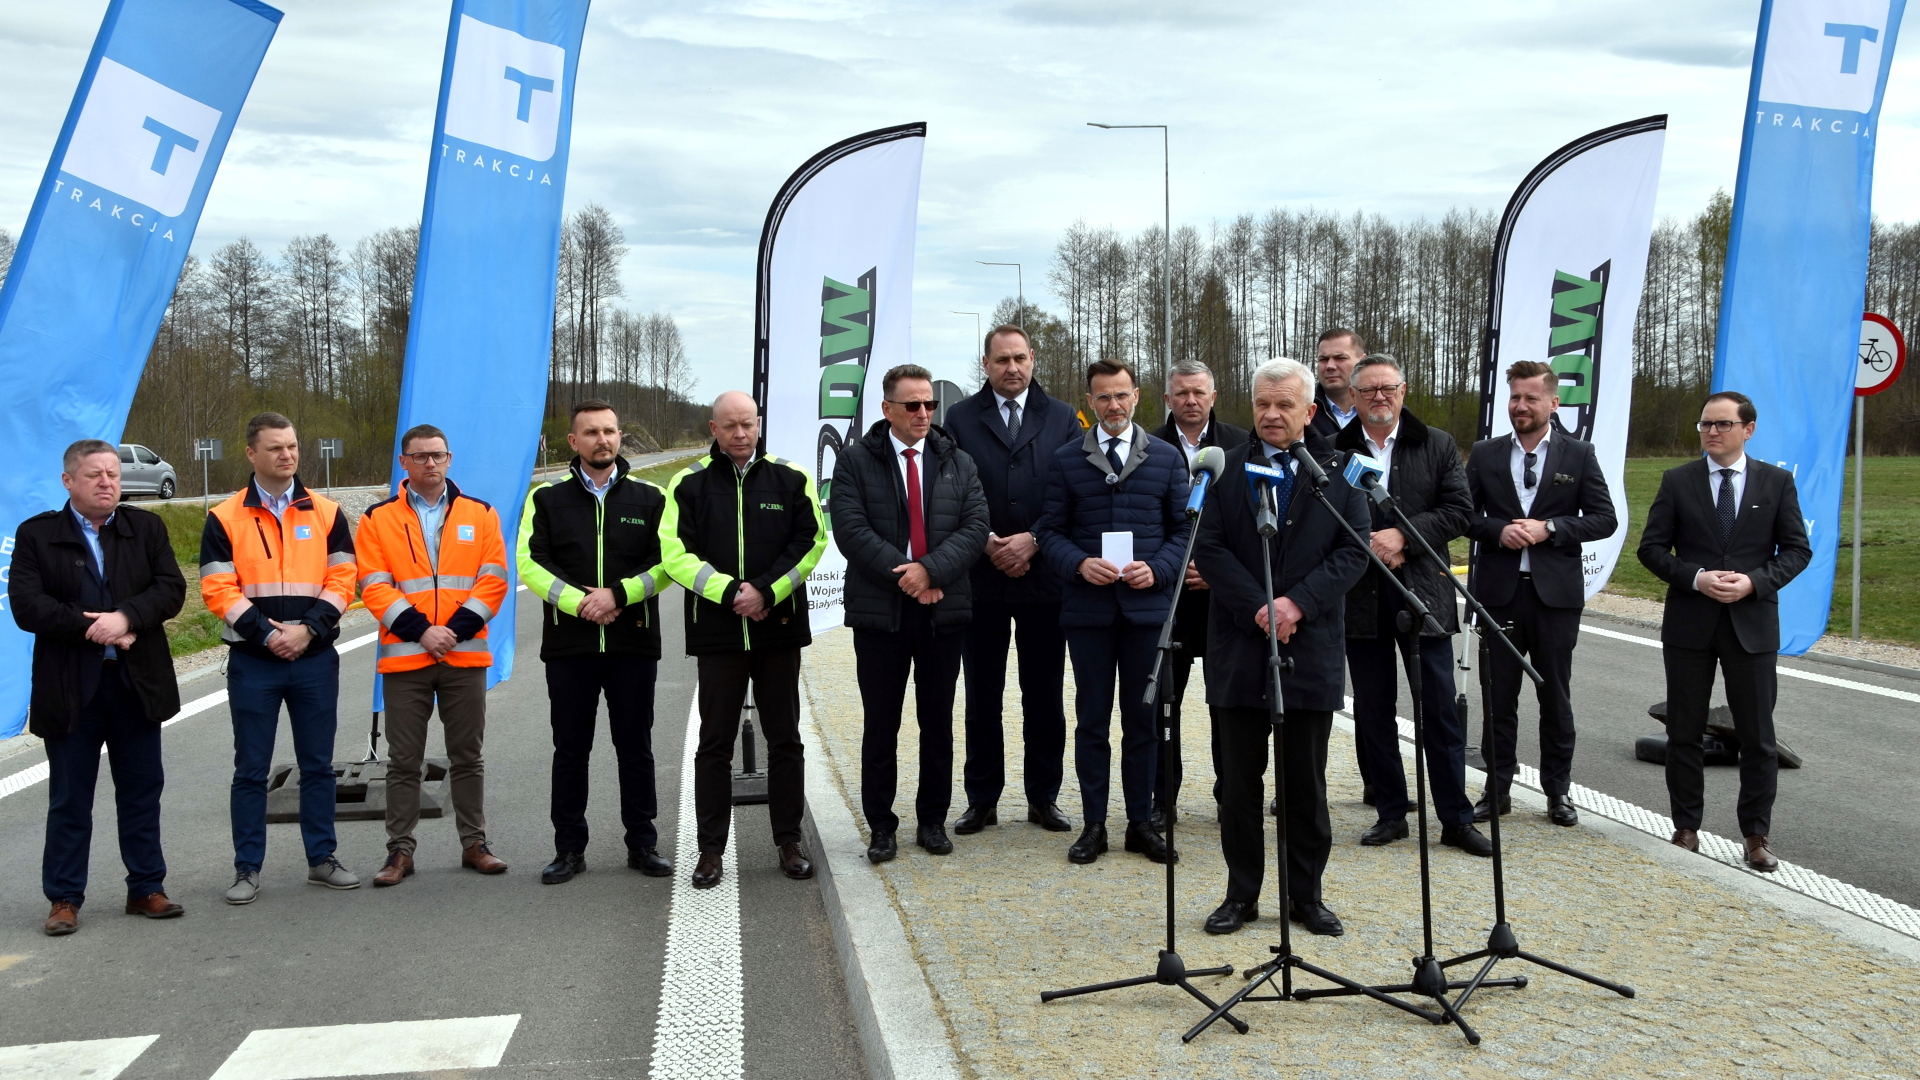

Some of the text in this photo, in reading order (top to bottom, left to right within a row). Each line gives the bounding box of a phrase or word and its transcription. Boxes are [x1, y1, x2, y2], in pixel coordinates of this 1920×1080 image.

[1823, 22, 1879, 75] T
[503, 65, 555, 123] T
[142, 115, 200, 177] T
[1755, 110, 1870, 139] TRAKCJA
[441, 143, 552, 186] TRAKCJA
[53, 180, 175, 243] TRAKCJA
[805, 571, 839, 581] dlaski
